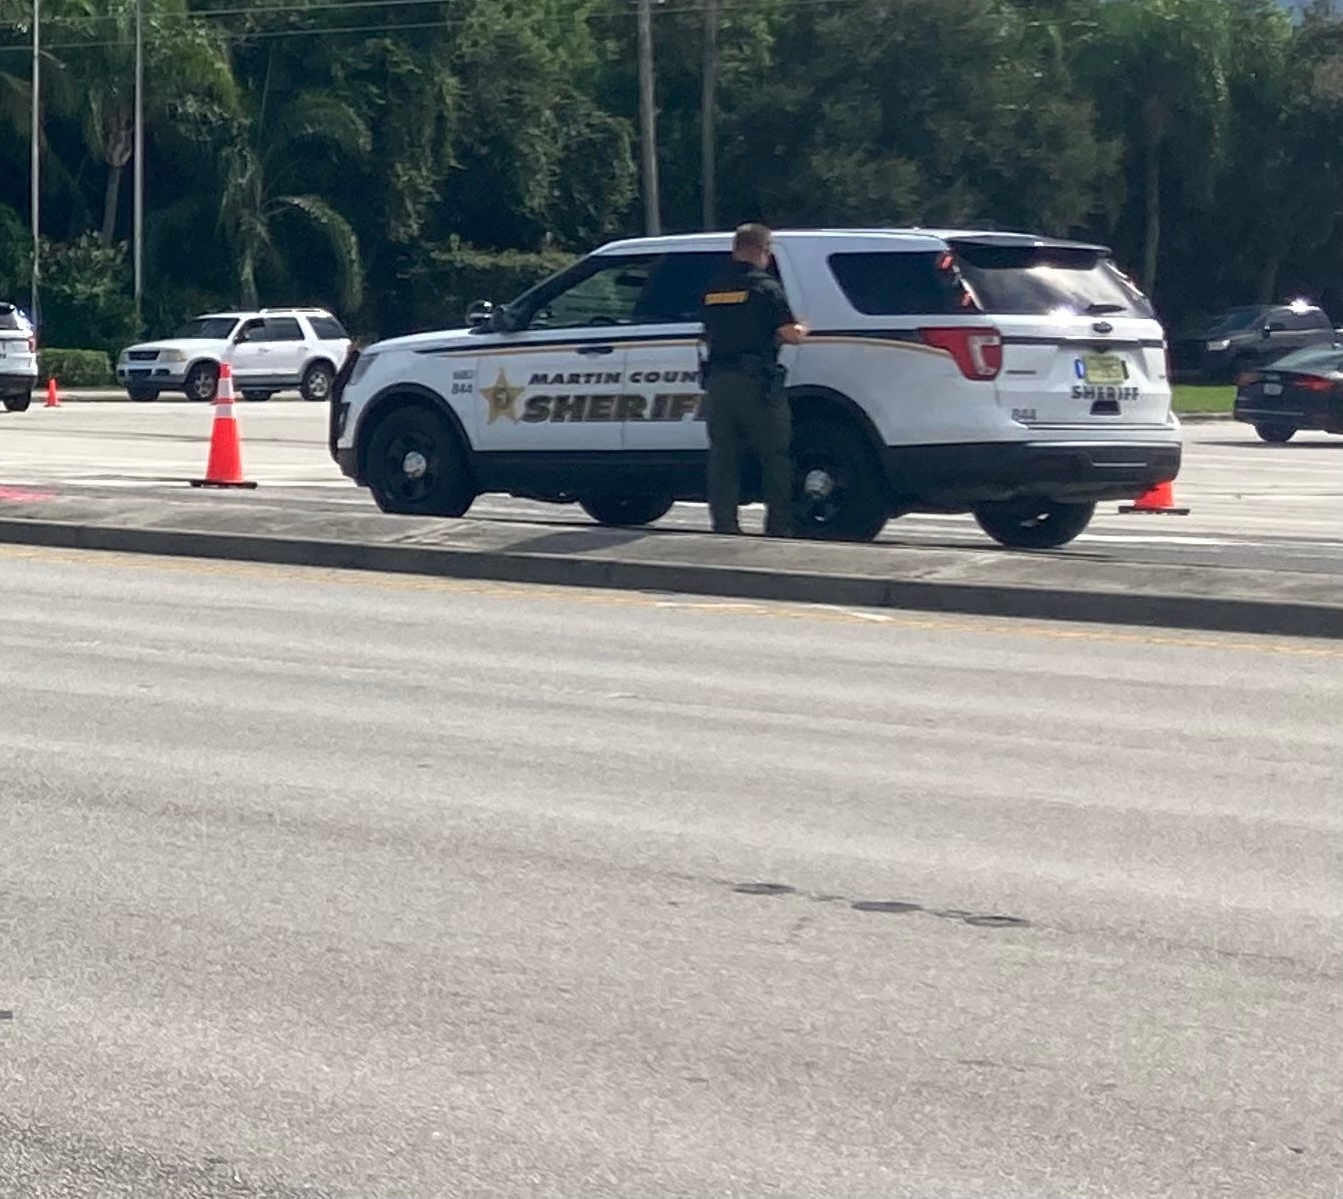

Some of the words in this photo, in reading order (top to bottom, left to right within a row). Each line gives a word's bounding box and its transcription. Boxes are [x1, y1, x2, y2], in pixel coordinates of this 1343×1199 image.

[528, 372, 620, 385] MARTIN
[629, 370, 702, 384] COUN
[451, 382, 474, 395] 844
[1072, 385, 1139, 401] SHERIFF
